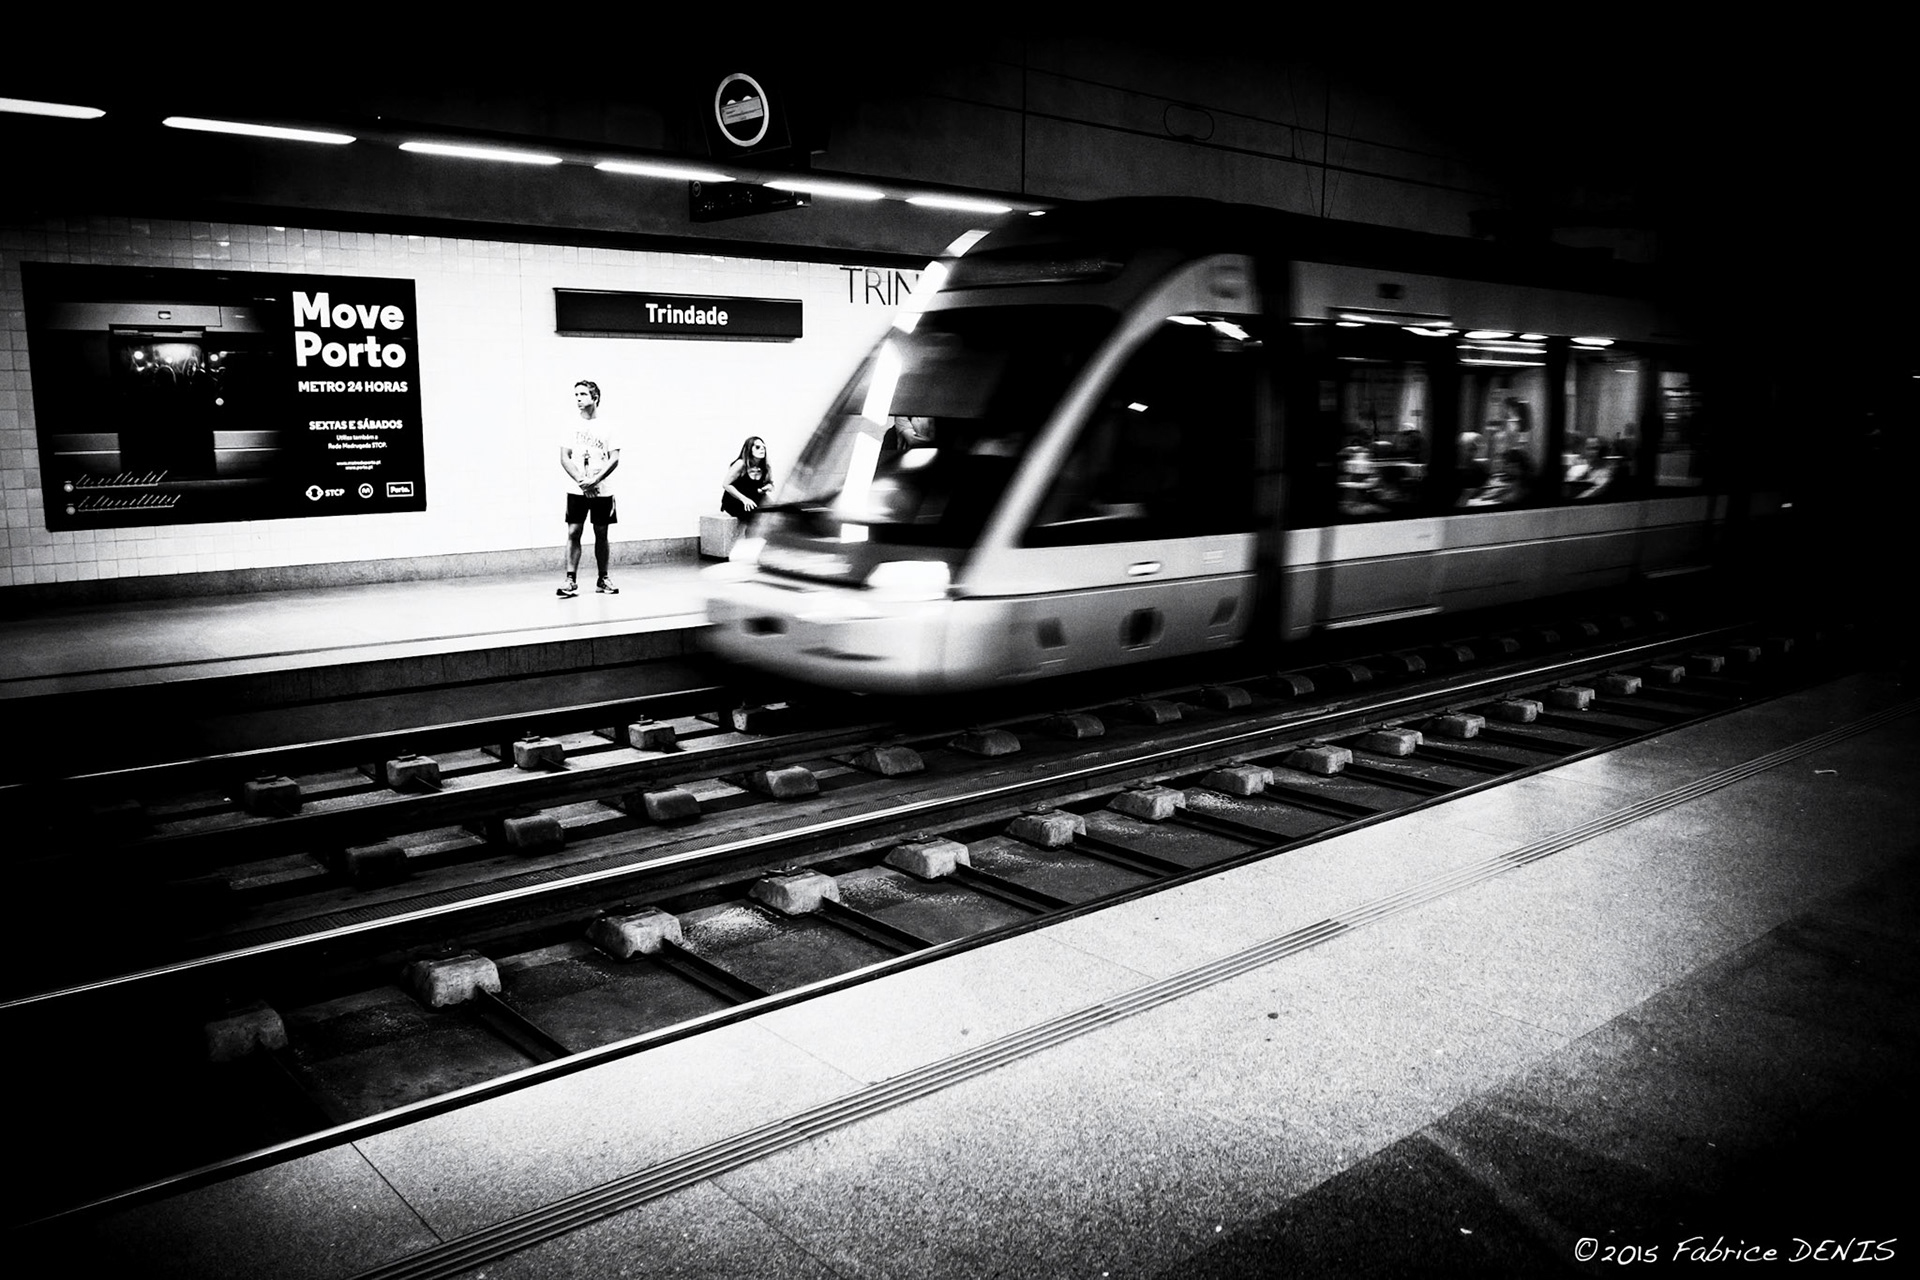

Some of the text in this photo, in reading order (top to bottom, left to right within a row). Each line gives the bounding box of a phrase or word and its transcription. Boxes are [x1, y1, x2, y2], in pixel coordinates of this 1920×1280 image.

[293, 291, 404, 330] Move
[645, 303, 729, 326] Trindade
[295, 331, 406, 368] Porto
[298, 381, 408, 392] METRO 24 HORAS
[309, 418, 403, 430] SEXTAS E SÁBADOS
[325, 488, 345, 497] STCP
